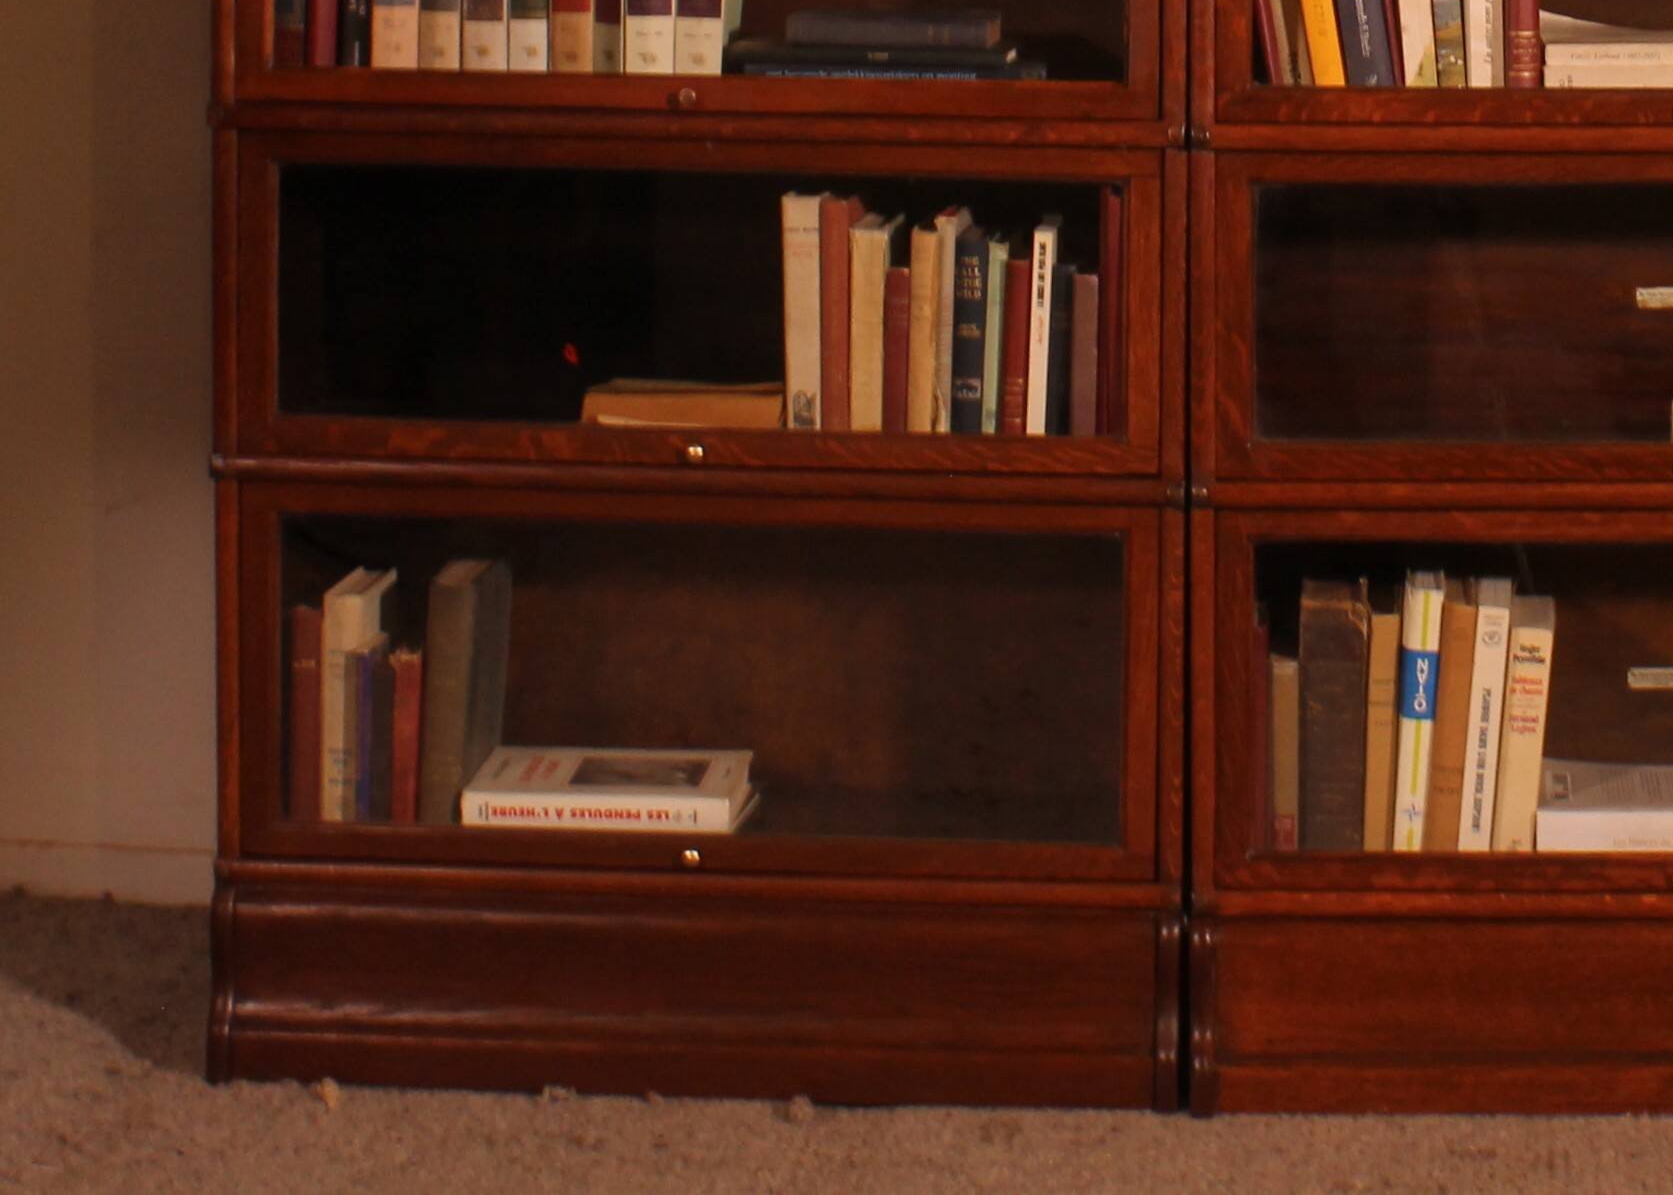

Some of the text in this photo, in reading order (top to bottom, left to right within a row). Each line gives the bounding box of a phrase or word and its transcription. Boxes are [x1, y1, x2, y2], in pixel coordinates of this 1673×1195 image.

[491, 805, 670, 822] LES PENDULES À L'HEURE
